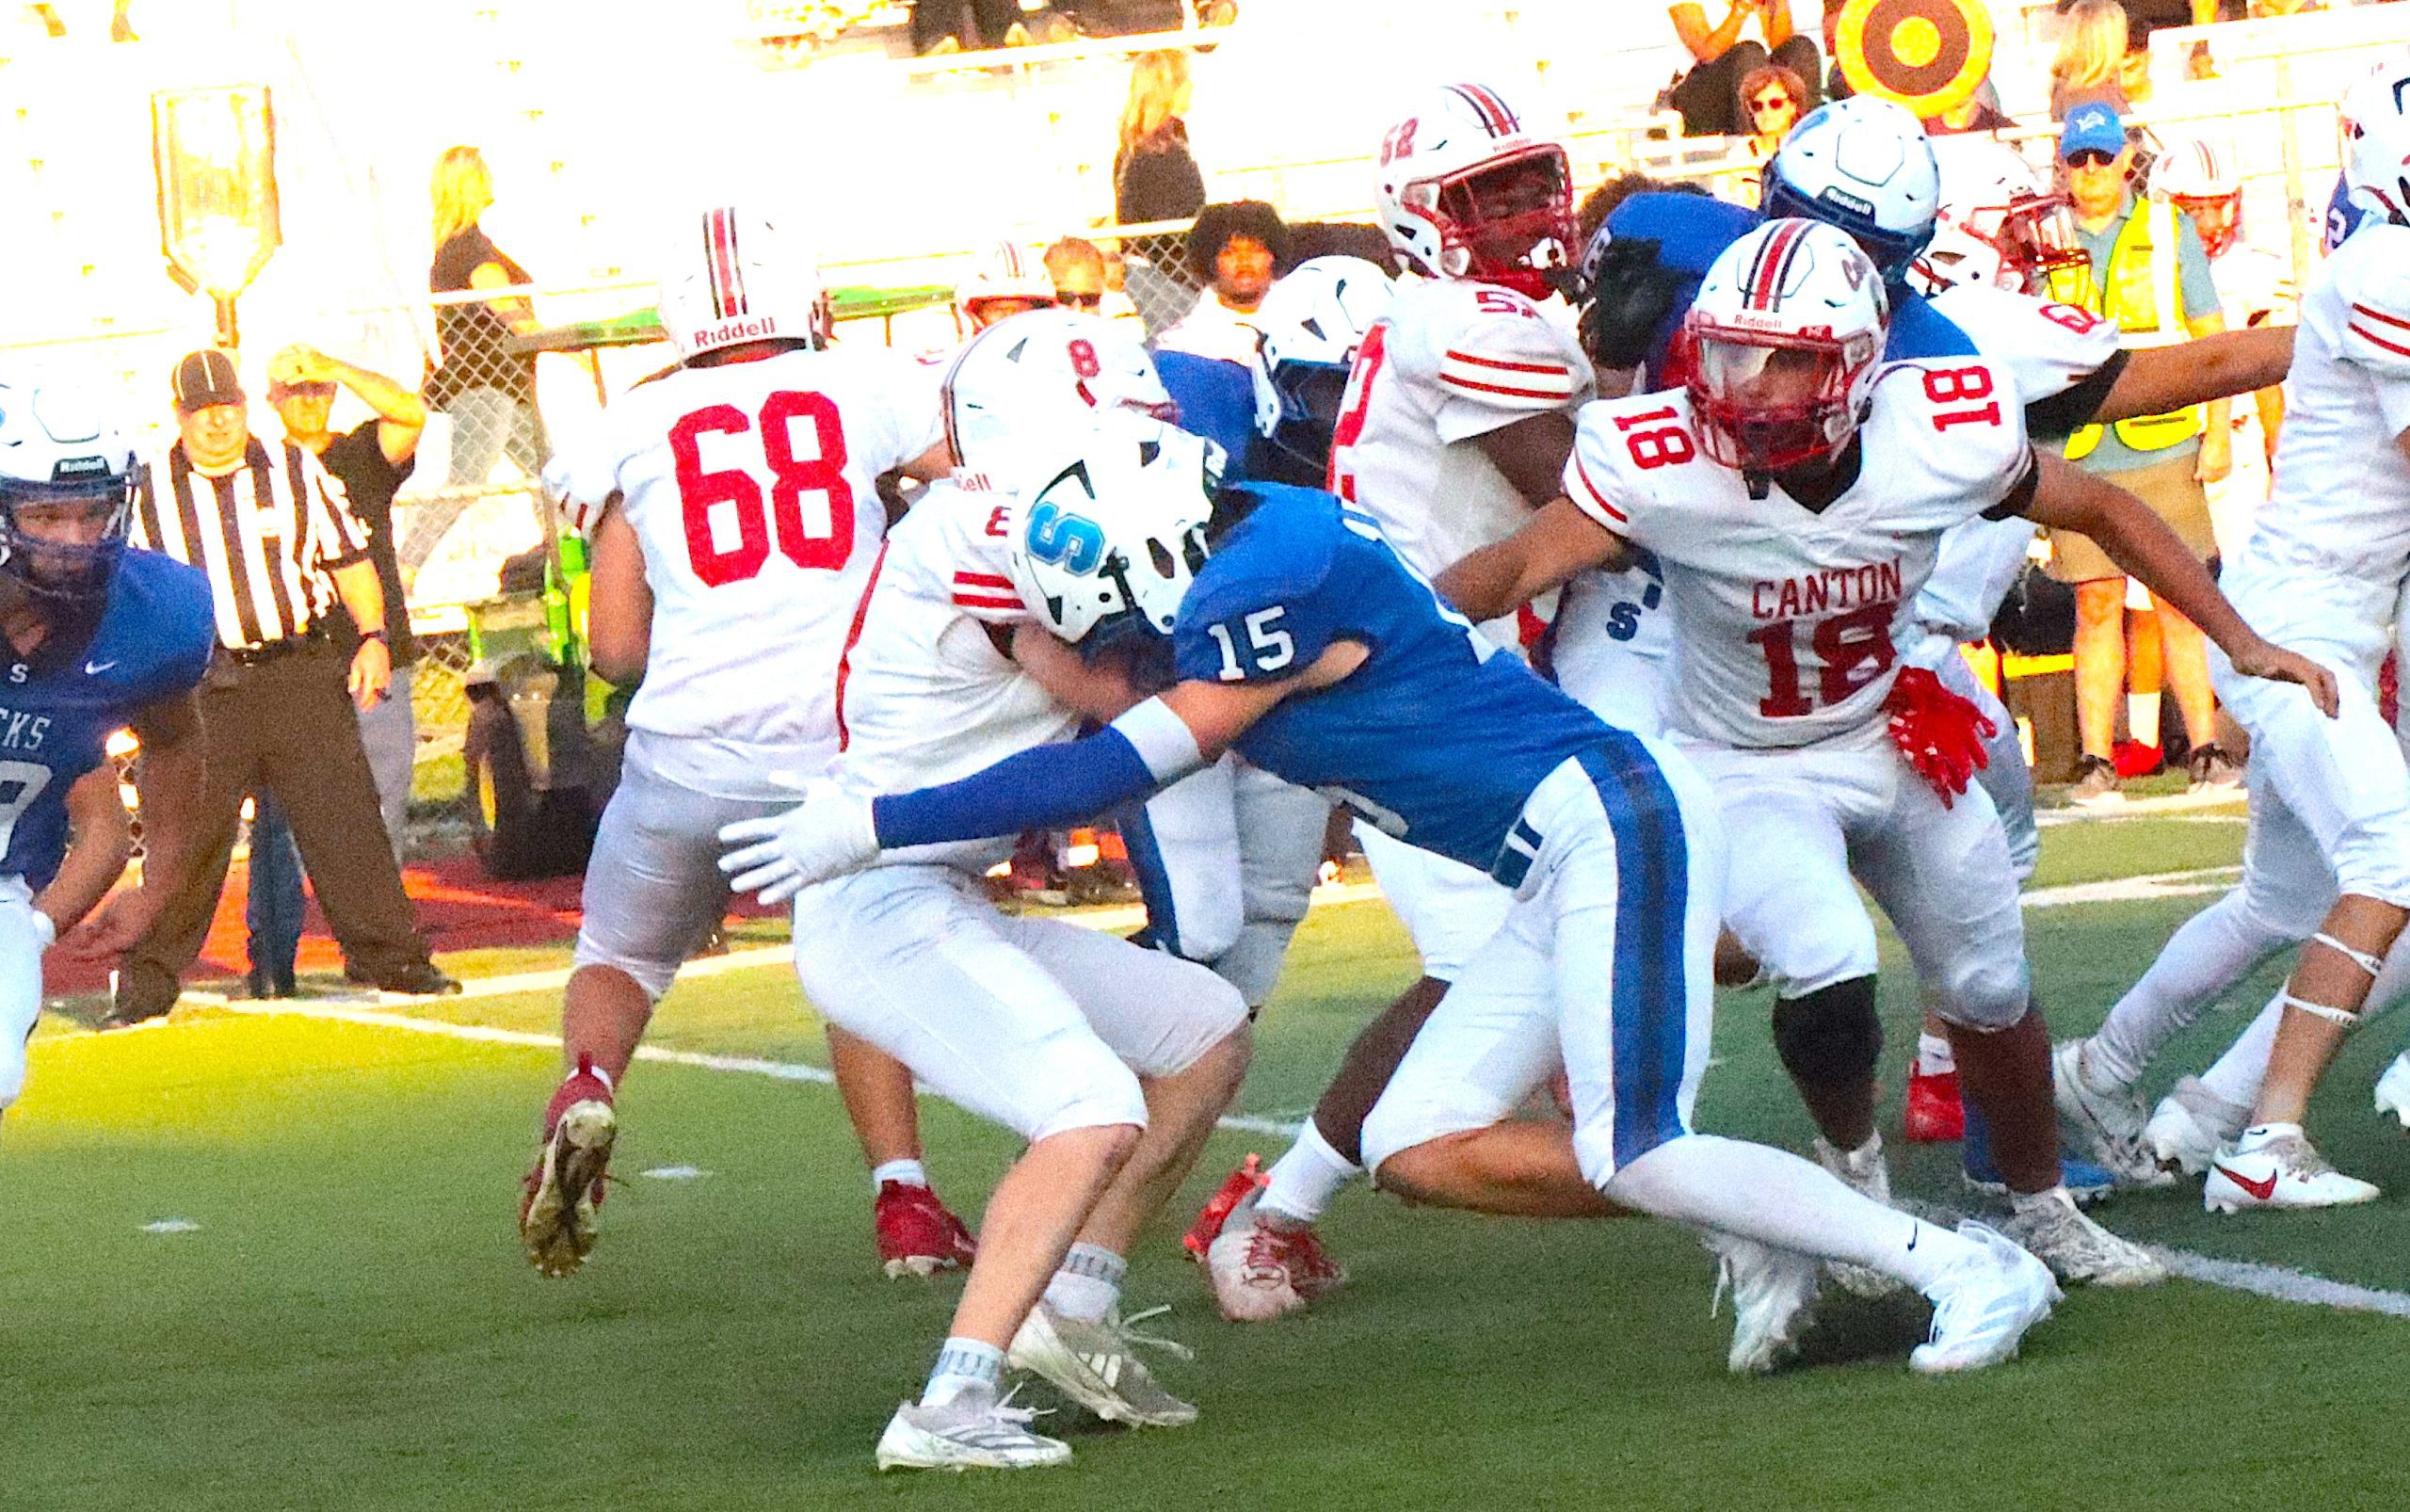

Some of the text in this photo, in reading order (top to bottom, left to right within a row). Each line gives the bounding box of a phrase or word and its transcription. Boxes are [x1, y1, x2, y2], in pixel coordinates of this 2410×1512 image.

[1826, 188, 1872, 216] Riddell
[694, 316, 776, 347] Riddell
[1734, 314, 1782, 329] Riddell
[1922, 364, 2002, 432] 18
[1613, 406, 1695, 470] 18
[59, 457, 105, 474] Riddell
[668, 390, 855, 588] 68
[1025, 501, 1106, 578] S
[1753, 556, 1902, 619] CANTON
[1207, 605, 1294, 681] 15
[1606, 602, 1641, 641] S
[9, 663, 28, 683] S
[1746, 600, 1898, 717] 18
[0, 709, 51, 750] KS
